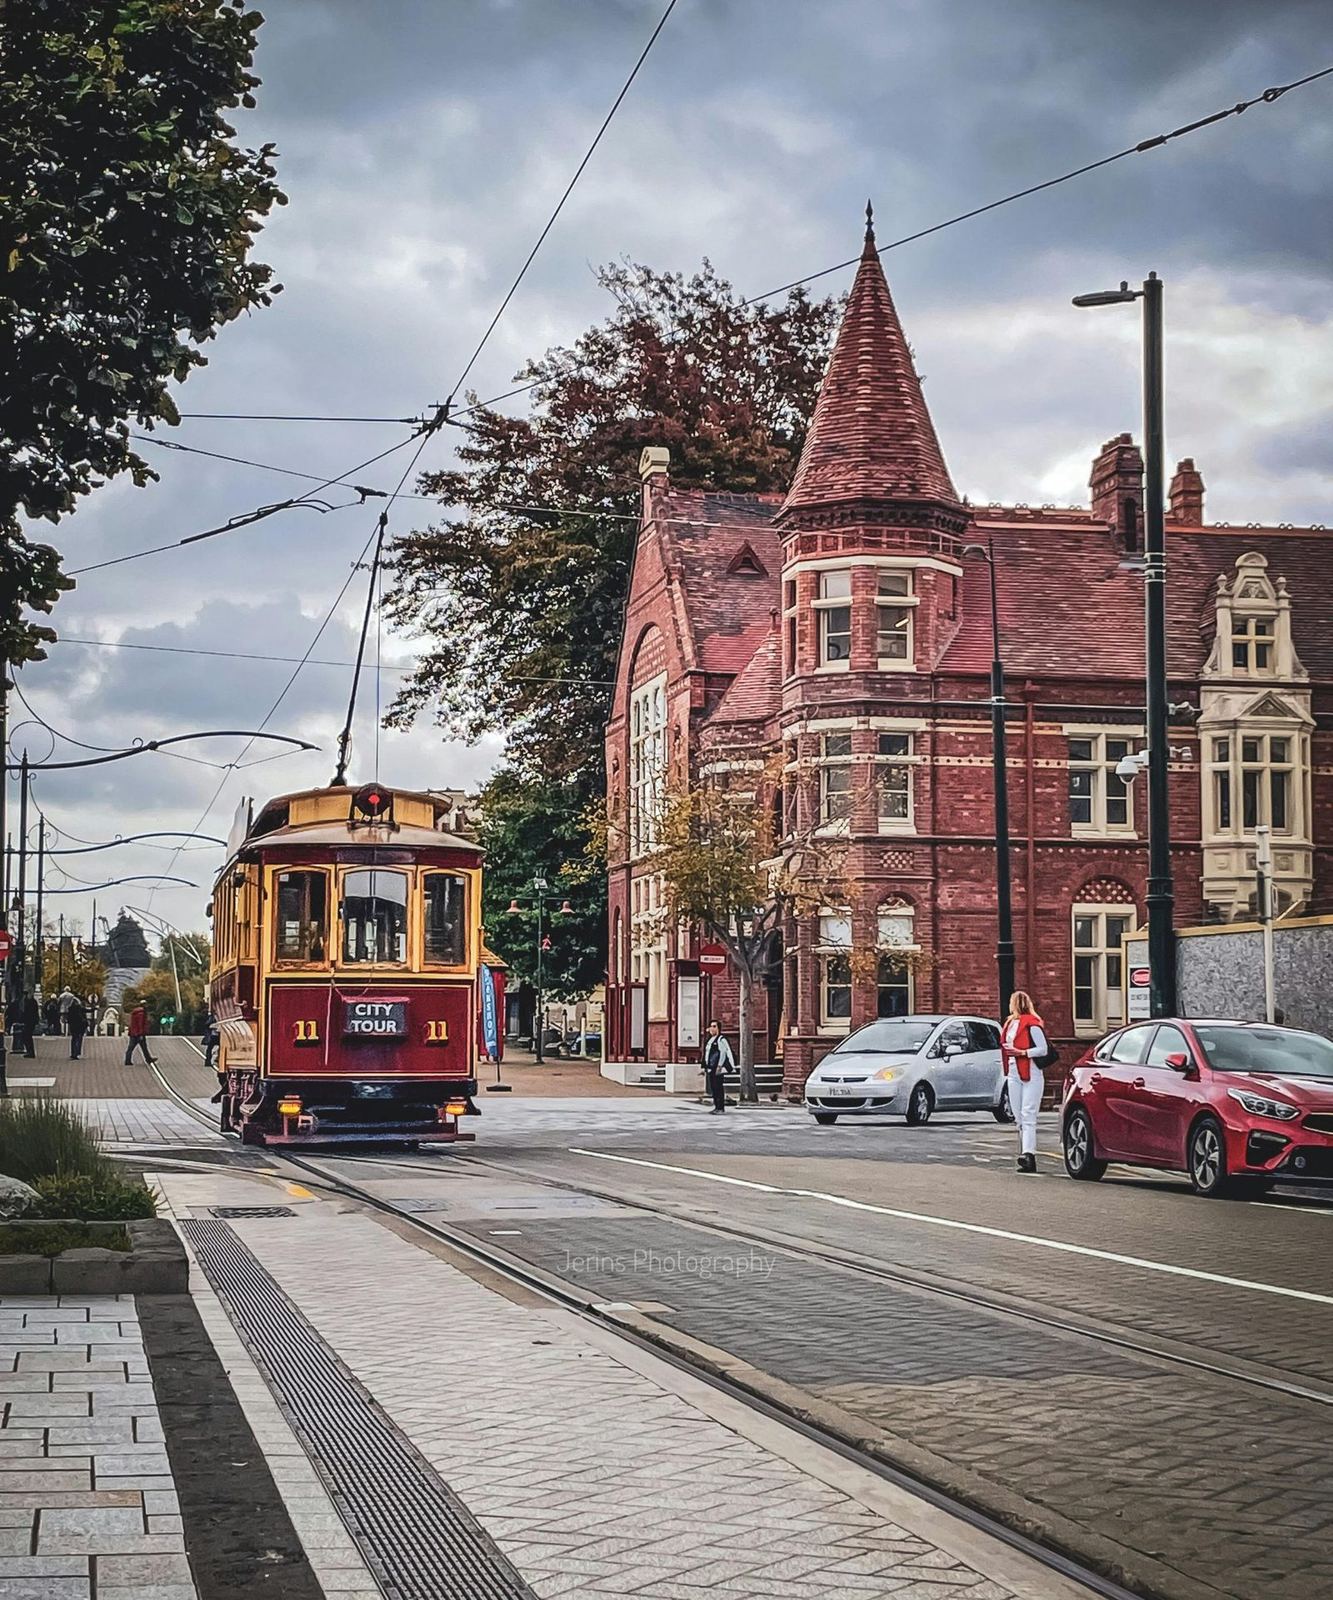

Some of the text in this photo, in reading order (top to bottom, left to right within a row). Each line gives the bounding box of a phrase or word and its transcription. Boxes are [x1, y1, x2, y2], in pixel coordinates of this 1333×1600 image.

[355, 1003, 394, 1016] CITY
[295, 1020, 320, 1040] 11
[351, 1020, 397, 1033] TOUR
[426, 1020, 449, 1040] 11
